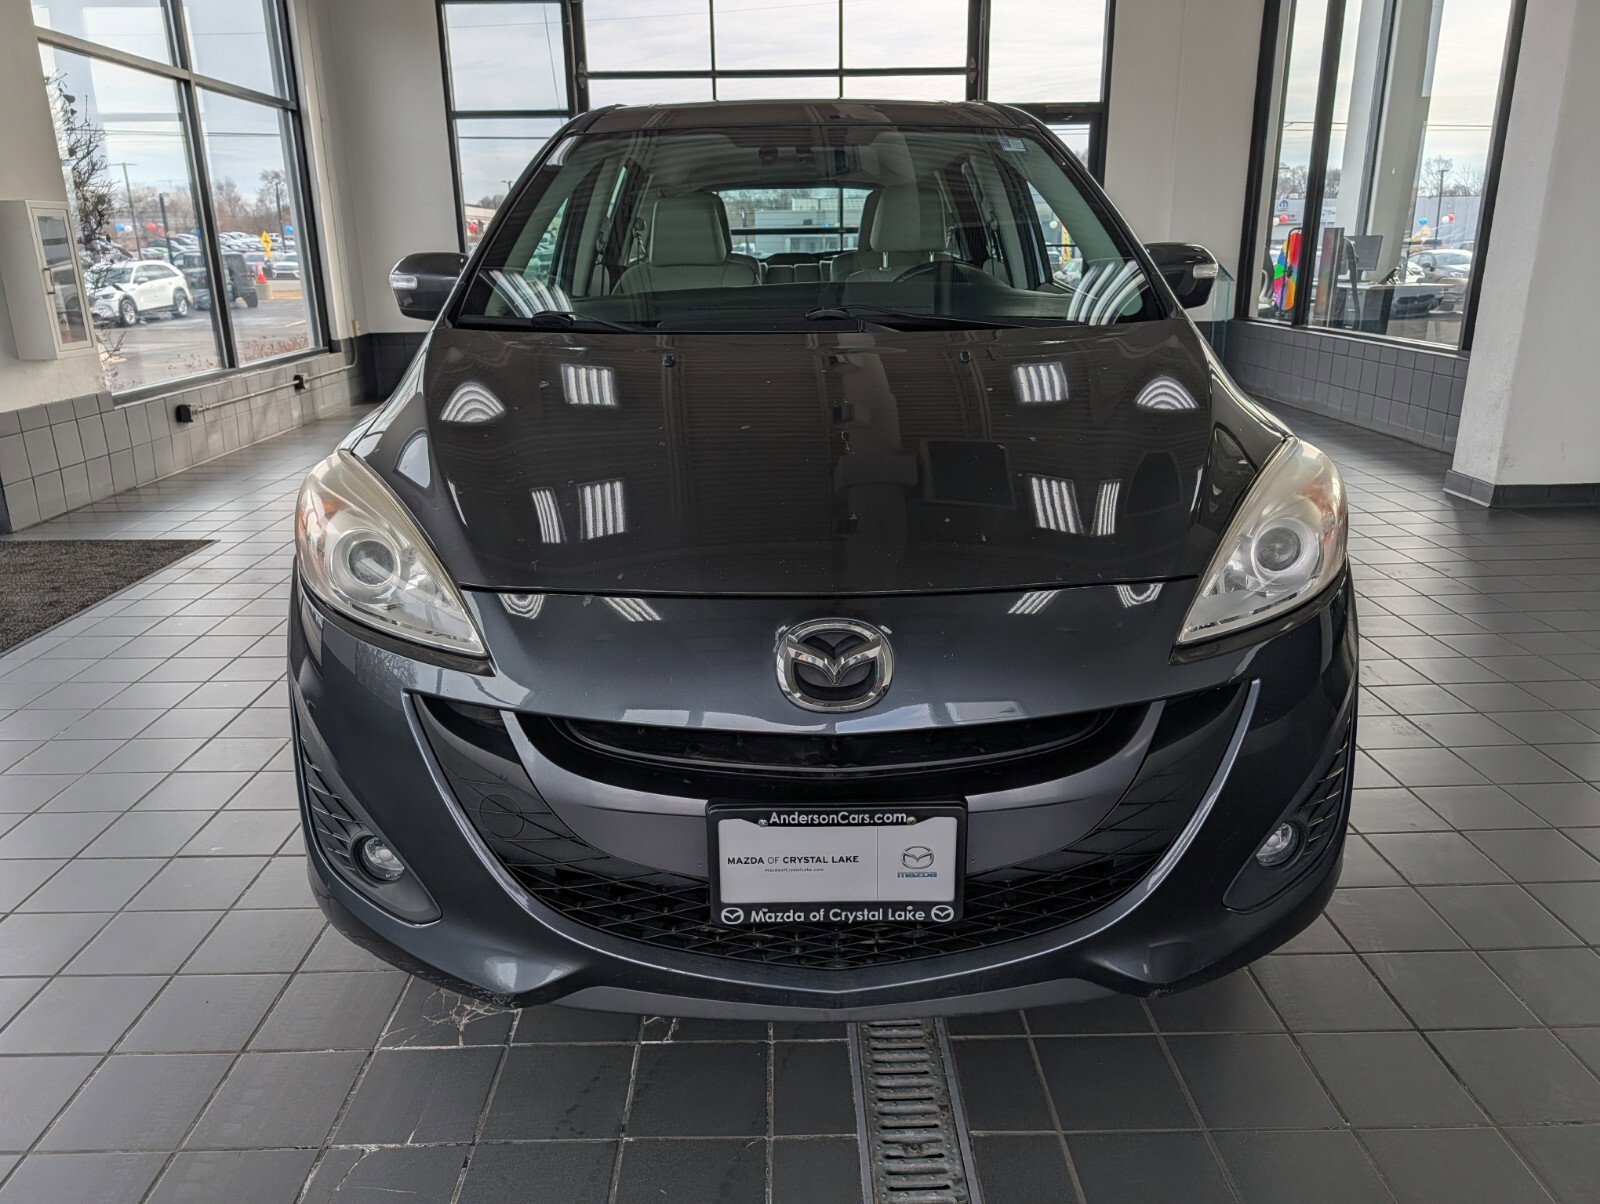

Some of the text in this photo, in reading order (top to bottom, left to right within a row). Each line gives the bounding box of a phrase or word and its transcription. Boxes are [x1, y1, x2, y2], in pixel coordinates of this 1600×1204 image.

[769, 811, 907, 824] AndersonCars.com
[727, 855, 860, 865] MAZDA OF CRYSTAL LAKE
[750, 907, 926, 924] Mazda of Crystal Lake
